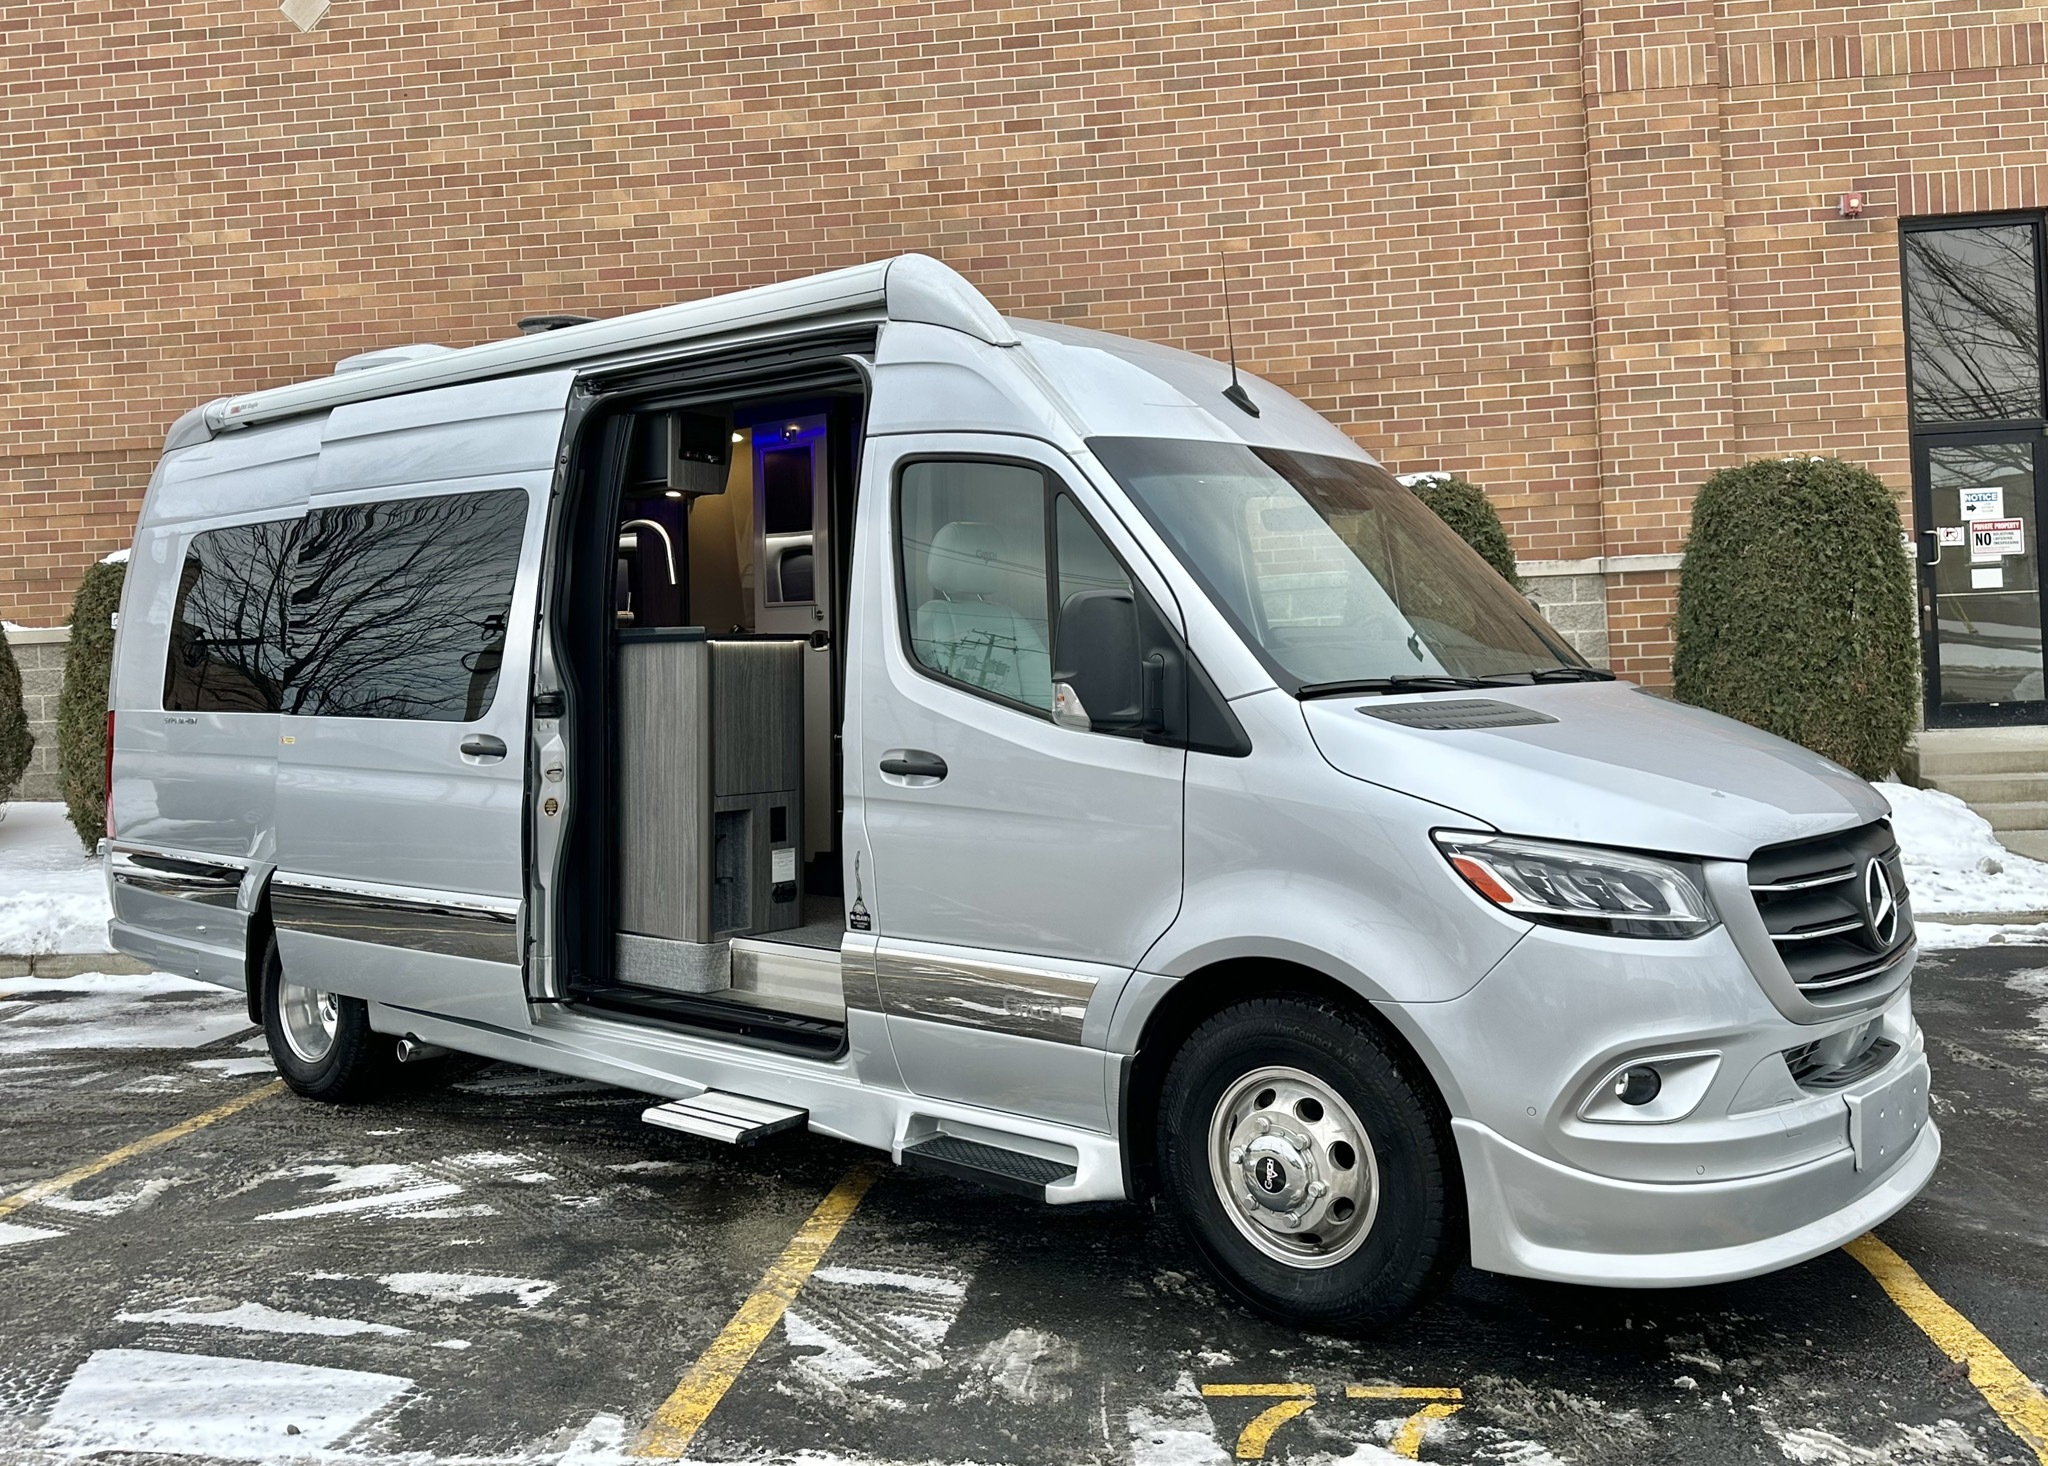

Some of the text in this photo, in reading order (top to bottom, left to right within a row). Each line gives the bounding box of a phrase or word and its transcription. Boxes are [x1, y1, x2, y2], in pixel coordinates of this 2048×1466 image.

[1965, 493, 1997, 502] NOTICE
[1975, 532, 1992, 546] NO
[1274, 1022, 1332, 1048] VanContact
[1201, 1383, 1465, 1460] 77
